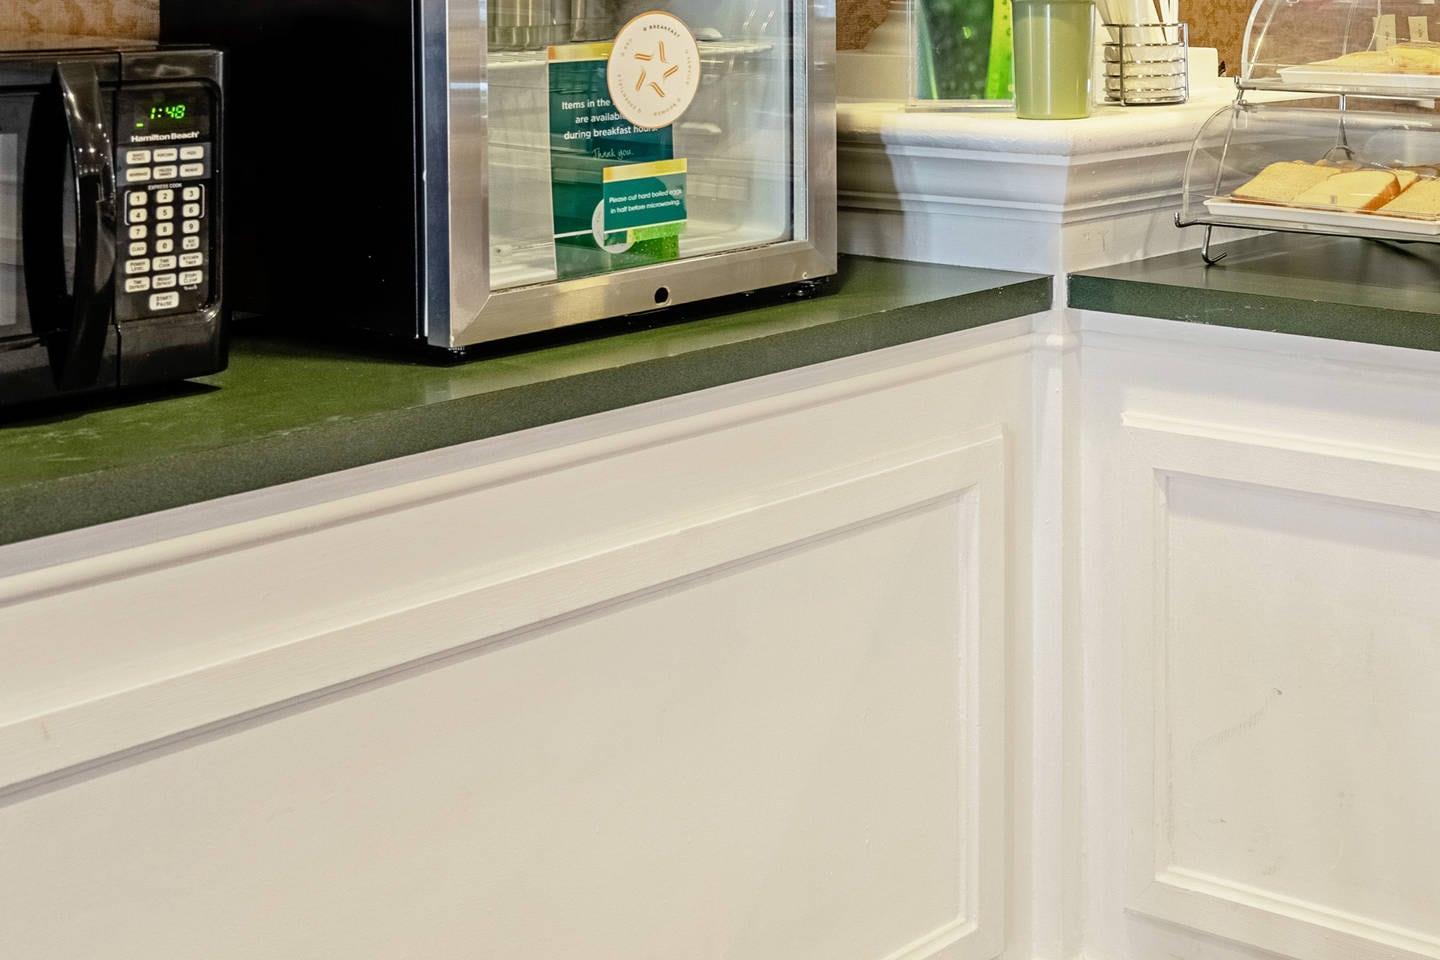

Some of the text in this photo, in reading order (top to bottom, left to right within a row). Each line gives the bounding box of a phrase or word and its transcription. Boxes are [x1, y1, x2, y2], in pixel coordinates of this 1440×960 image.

[562, 98, 611, 110] Items in the
[150, 104, 186, 119] 1:48
[575, 112, 625, 124] are availab
[130, 133, 171, 143] Hamilton
[563, 131, 592, 140] during
[593, 126, 632, 137] breakfast
[592, 147, 616, 159] Thank
[628, 204, 646, 212] before
